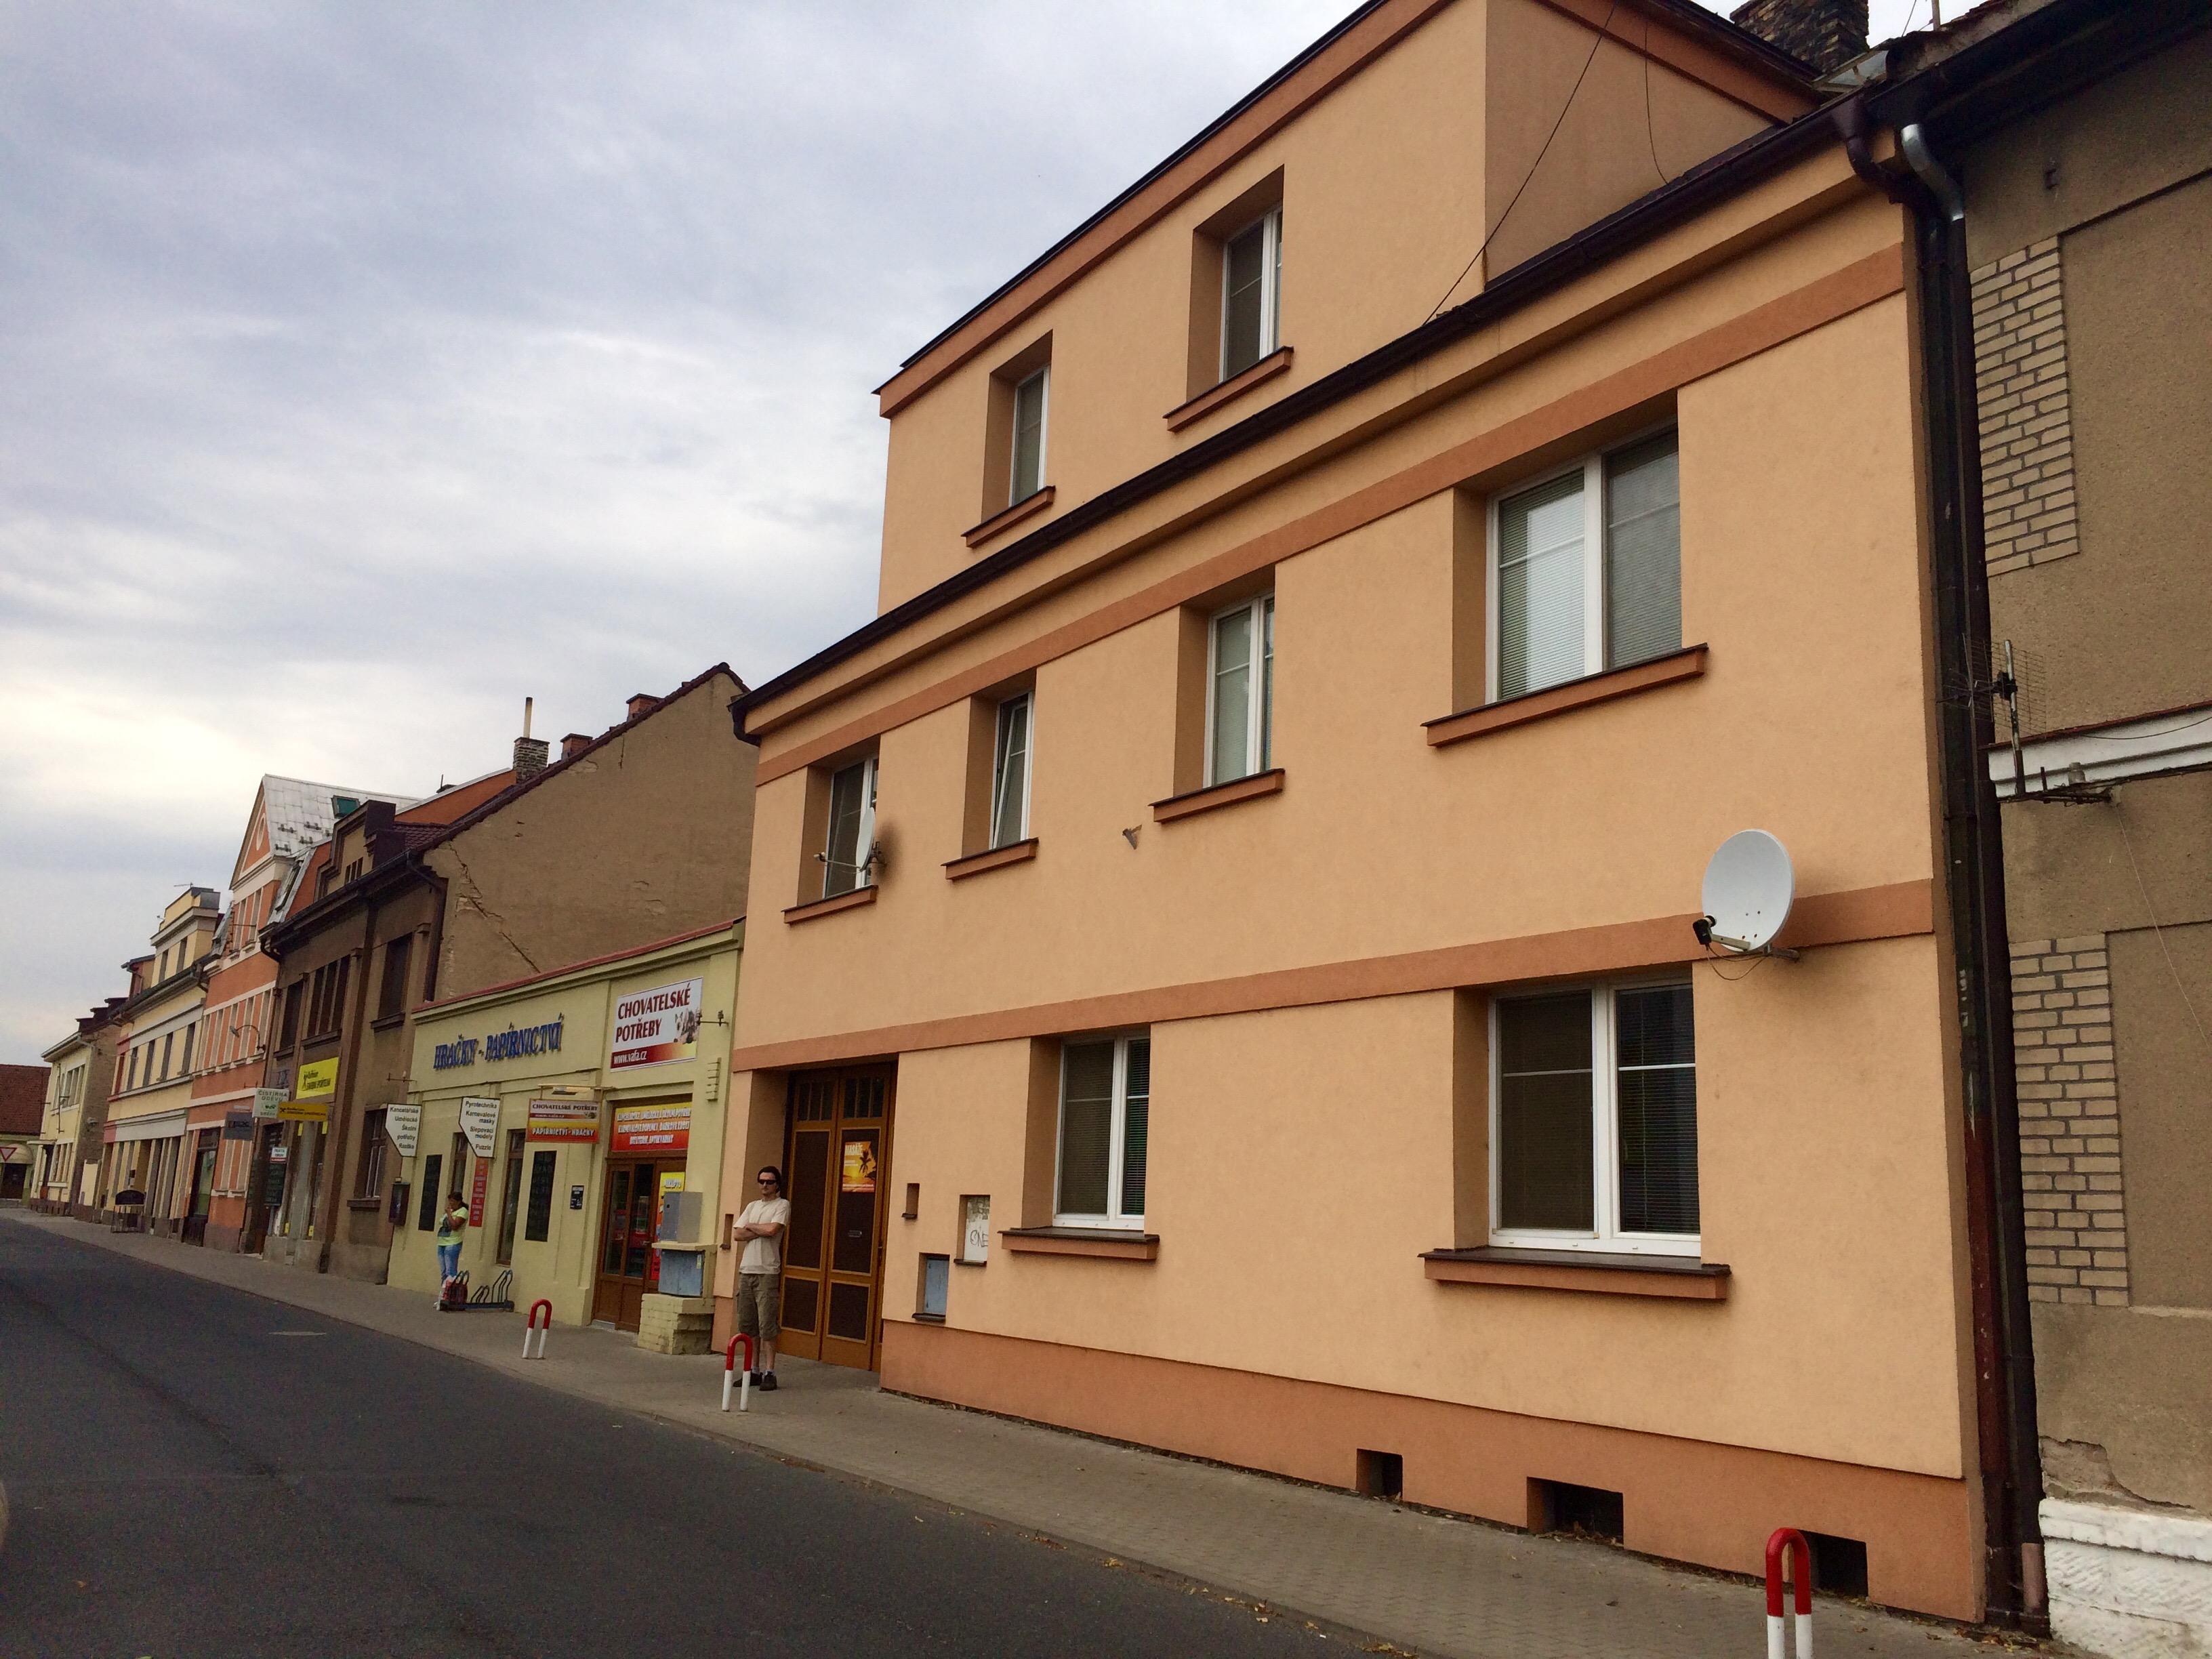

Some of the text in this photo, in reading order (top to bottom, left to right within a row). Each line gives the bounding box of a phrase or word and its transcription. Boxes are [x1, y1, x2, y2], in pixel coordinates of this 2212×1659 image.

[617, 983, 691, 1020] CHOVATELSKÉ
[615, 1017, 662, 1043] POTŘEBY
[433, 1033, 478, 1069] HRAČKY
[485, 1012, 564, 1061] PAPÍRNICTVÍ
[614, 1050, 647, 1065] www.vafa.cz
[466, 1101, 497, 1109] Pyrotechnika
[532, 1126, 569, 1136] PAPÍRNICTVÍ
[571, 1127, 594, 1136] HRAČKY
